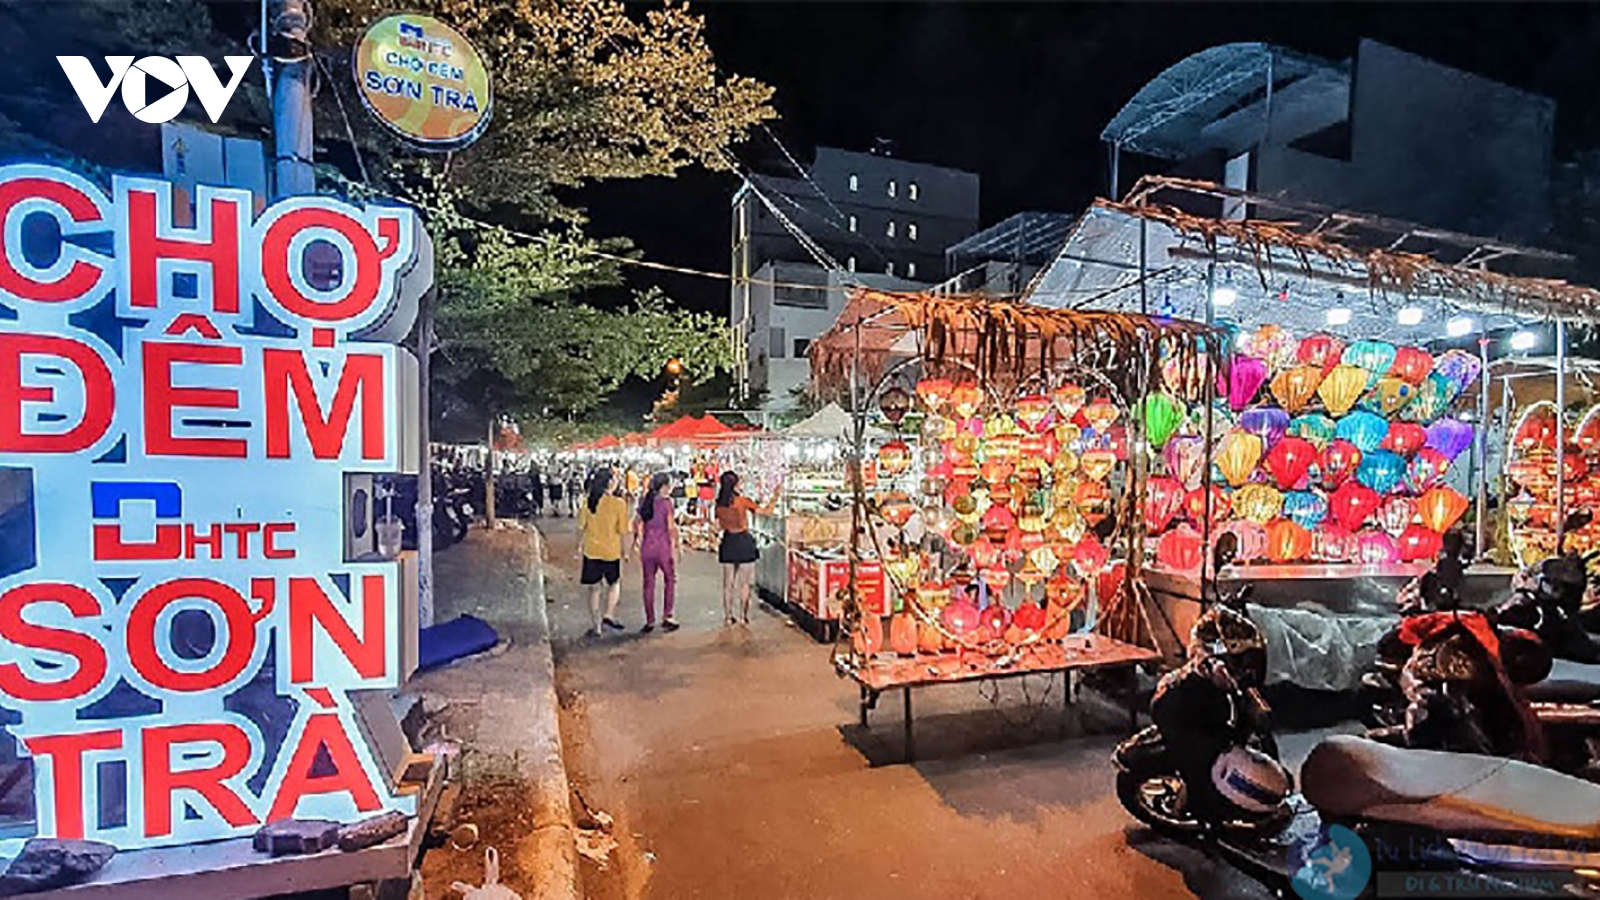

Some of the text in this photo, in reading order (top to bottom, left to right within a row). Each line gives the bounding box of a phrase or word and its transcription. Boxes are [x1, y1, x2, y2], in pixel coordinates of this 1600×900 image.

[366, 71, 422, 100] SƠN
[0, 178, 400, 347] CHỢ
[0, 314, 383, 460] ĐÊM
[0, 575, 386, 701] SƠN
[24, 688, 383, 839] TRÀ
